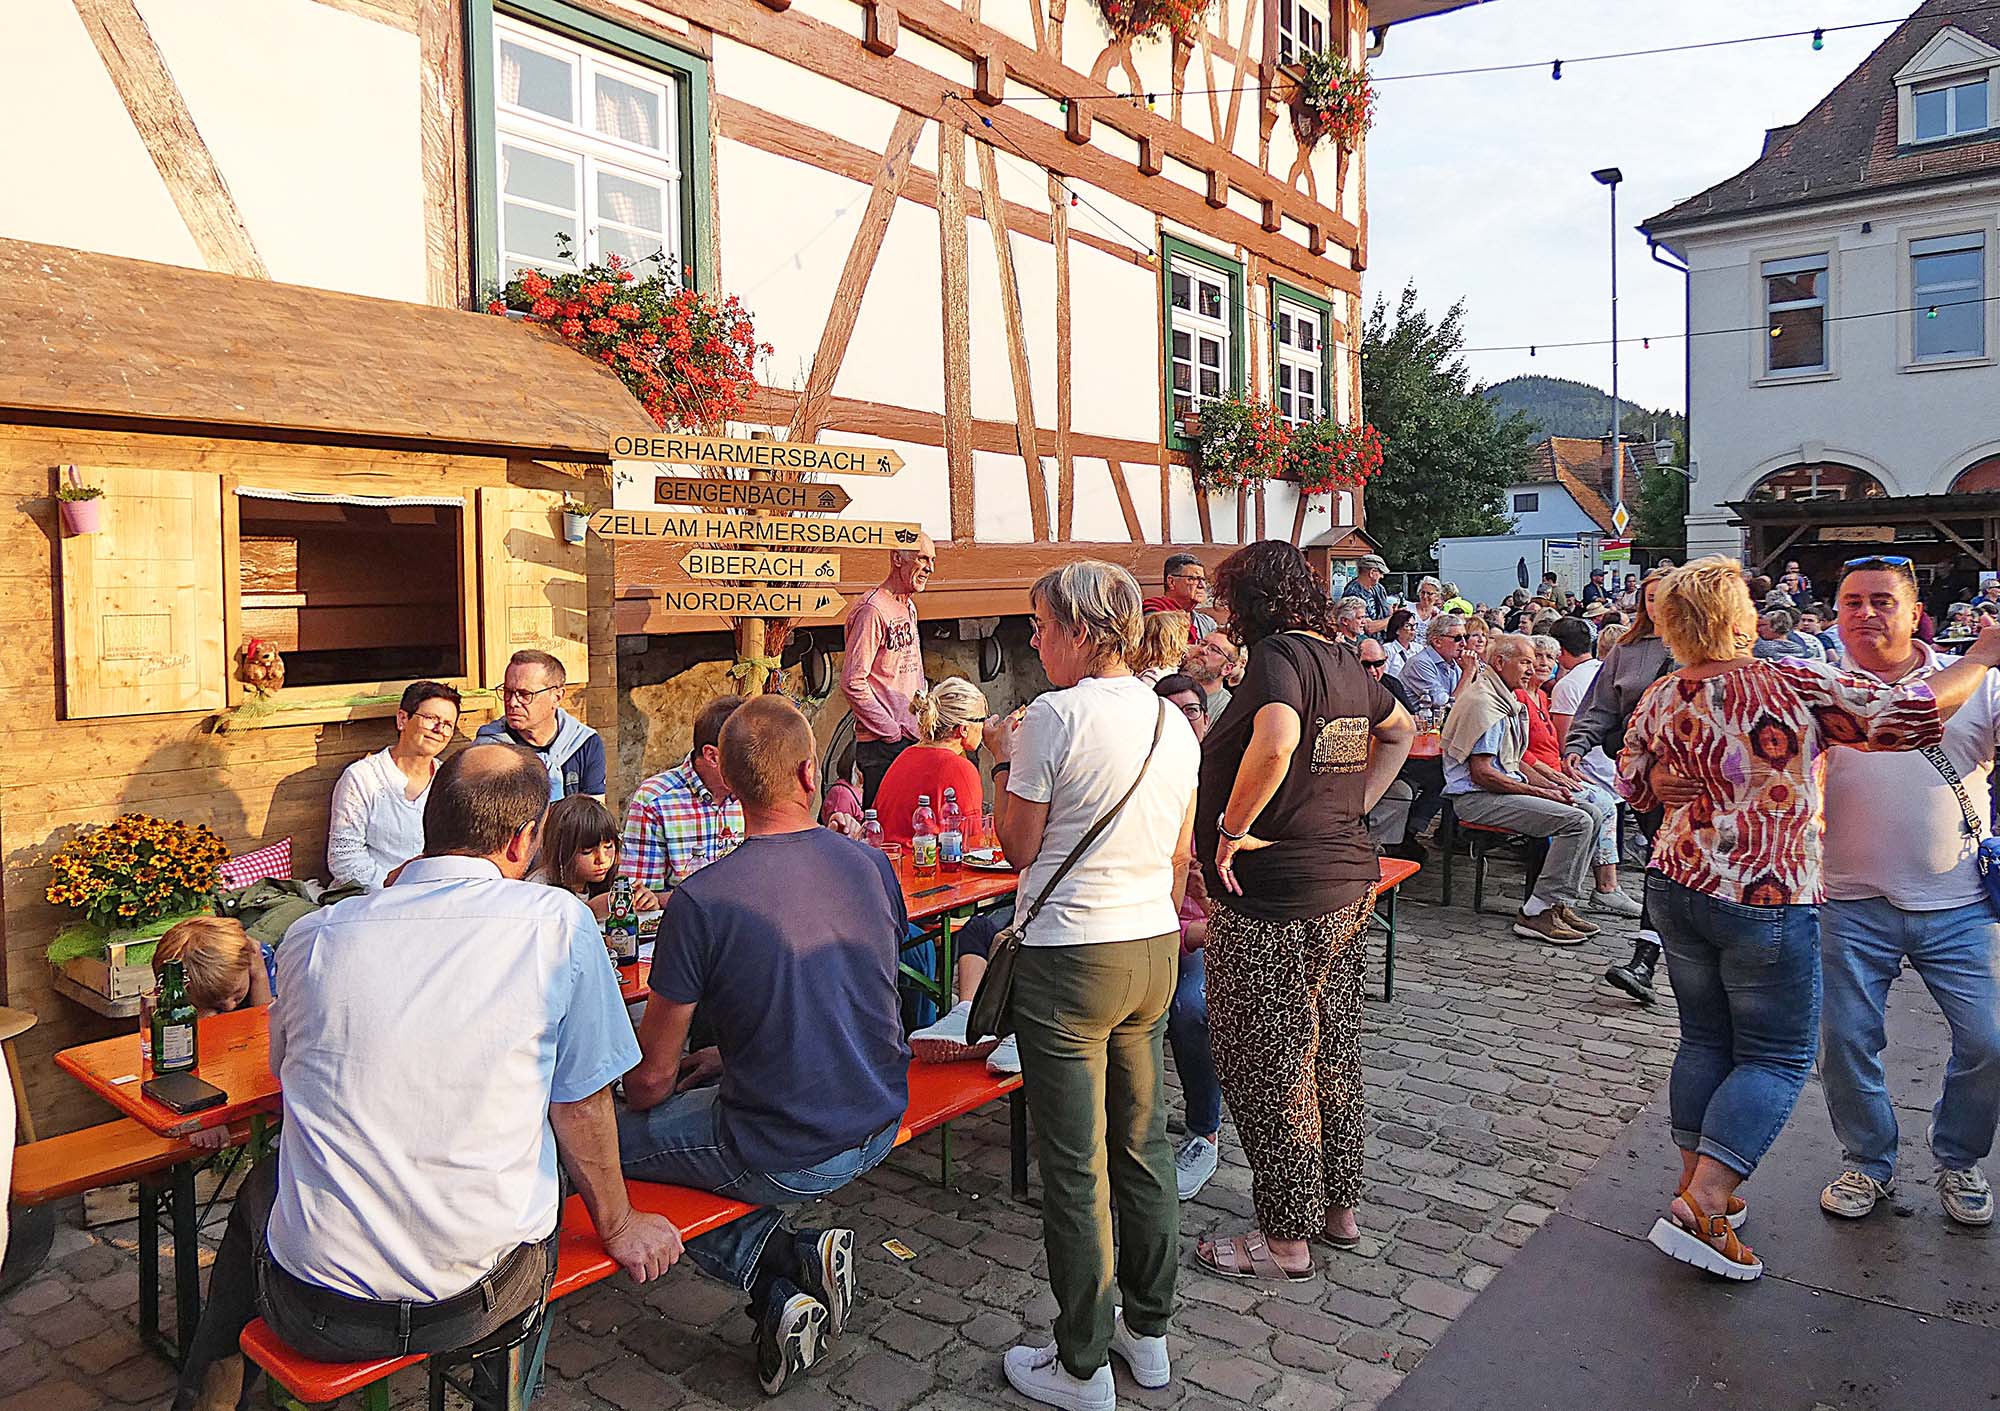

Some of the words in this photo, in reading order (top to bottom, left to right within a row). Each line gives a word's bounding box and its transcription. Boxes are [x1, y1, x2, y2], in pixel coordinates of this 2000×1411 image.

[614, 436, 865, 472] OBERHARMERSBACH
[658, 481, 806, 507] GENGENBACH
[598, 515, 656, 536] ZELL
[662, 518, 698, 538] AM
[706, 520, 883, 544] HARMERSBACH
[689, 555, 804, 577] BIBERACH
[665, 592, 802, 612] NORDRACH
